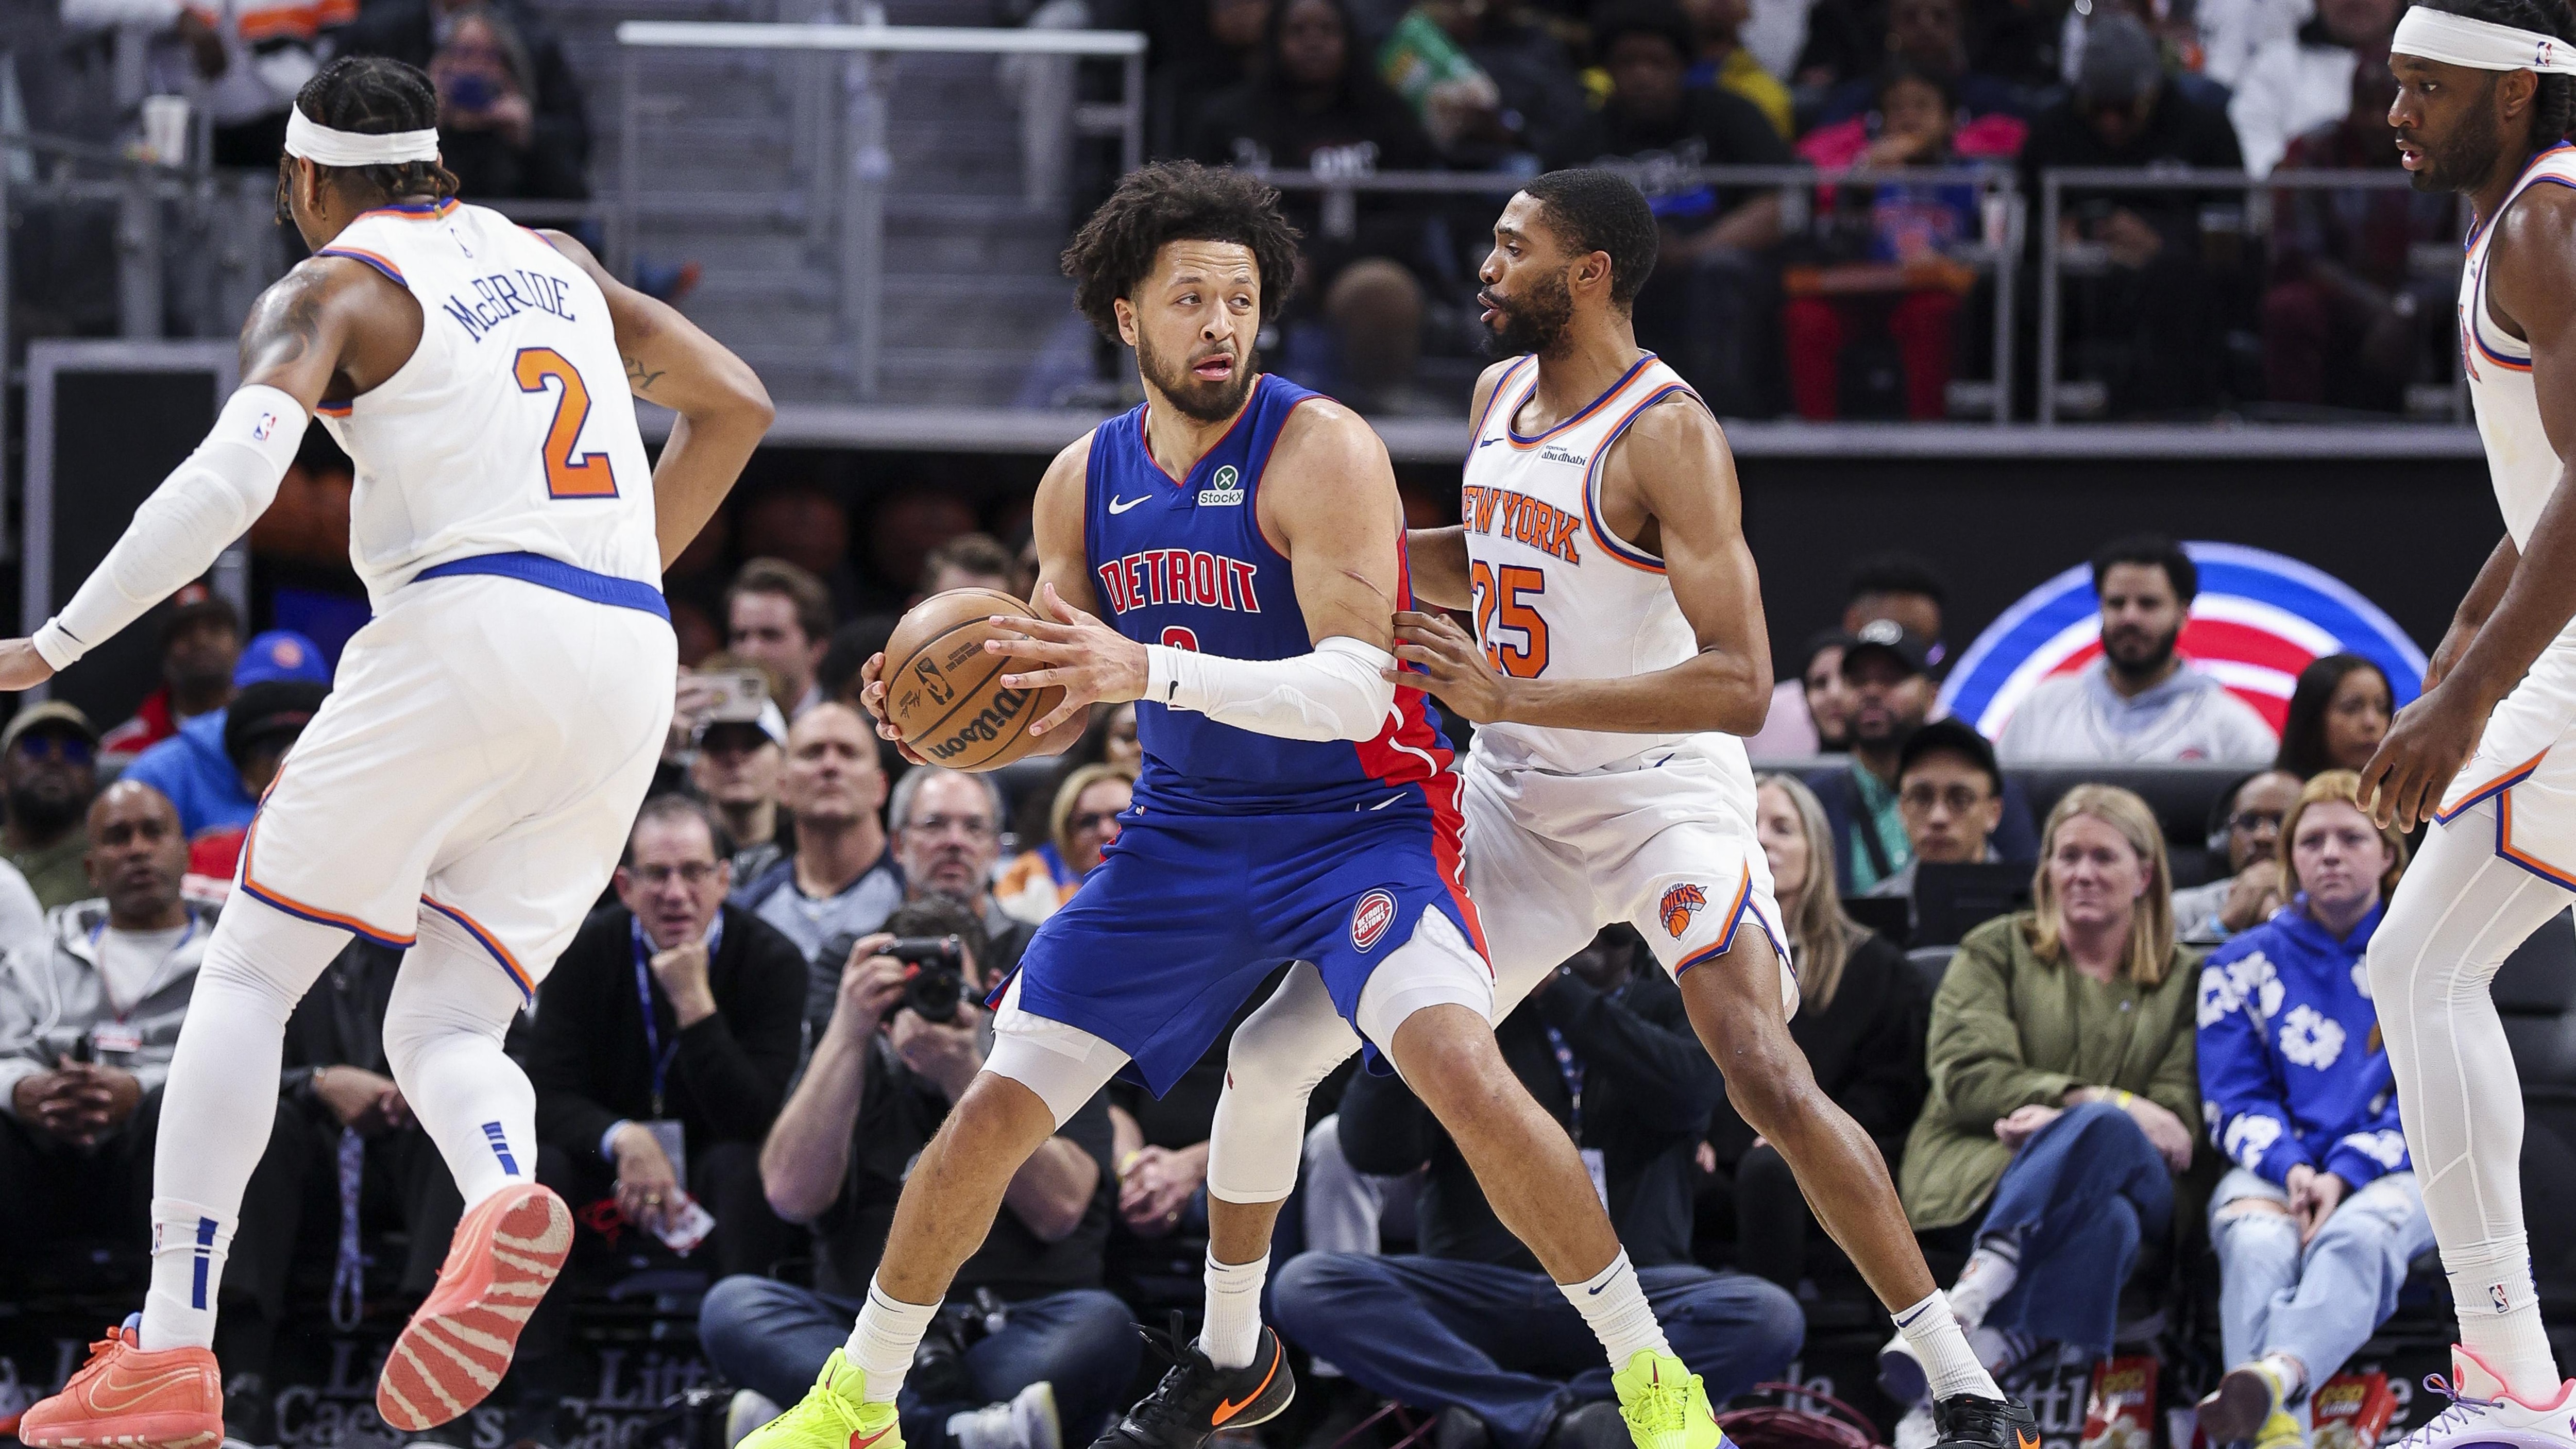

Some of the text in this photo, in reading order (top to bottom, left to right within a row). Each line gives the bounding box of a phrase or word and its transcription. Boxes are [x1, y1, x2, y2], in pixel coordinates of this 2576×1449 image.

[443, 269, 575, 344] McBRIDE
[512, 347, 620, 500] 2
[1541, 450, 1588, 466] abu dhabi
[1200, 491, 1243, 503] StockX
[1501, 491, 1583, 568] YORK
[1097, 548, 1261, 616] DETROIT
[1471, 559, 1550, 679] 25
[927, 688, 1033, 760] Wilson
[1357, 902, 1385, 929] DETROIT
[1357, 910, 1386, 937] PISTONS
